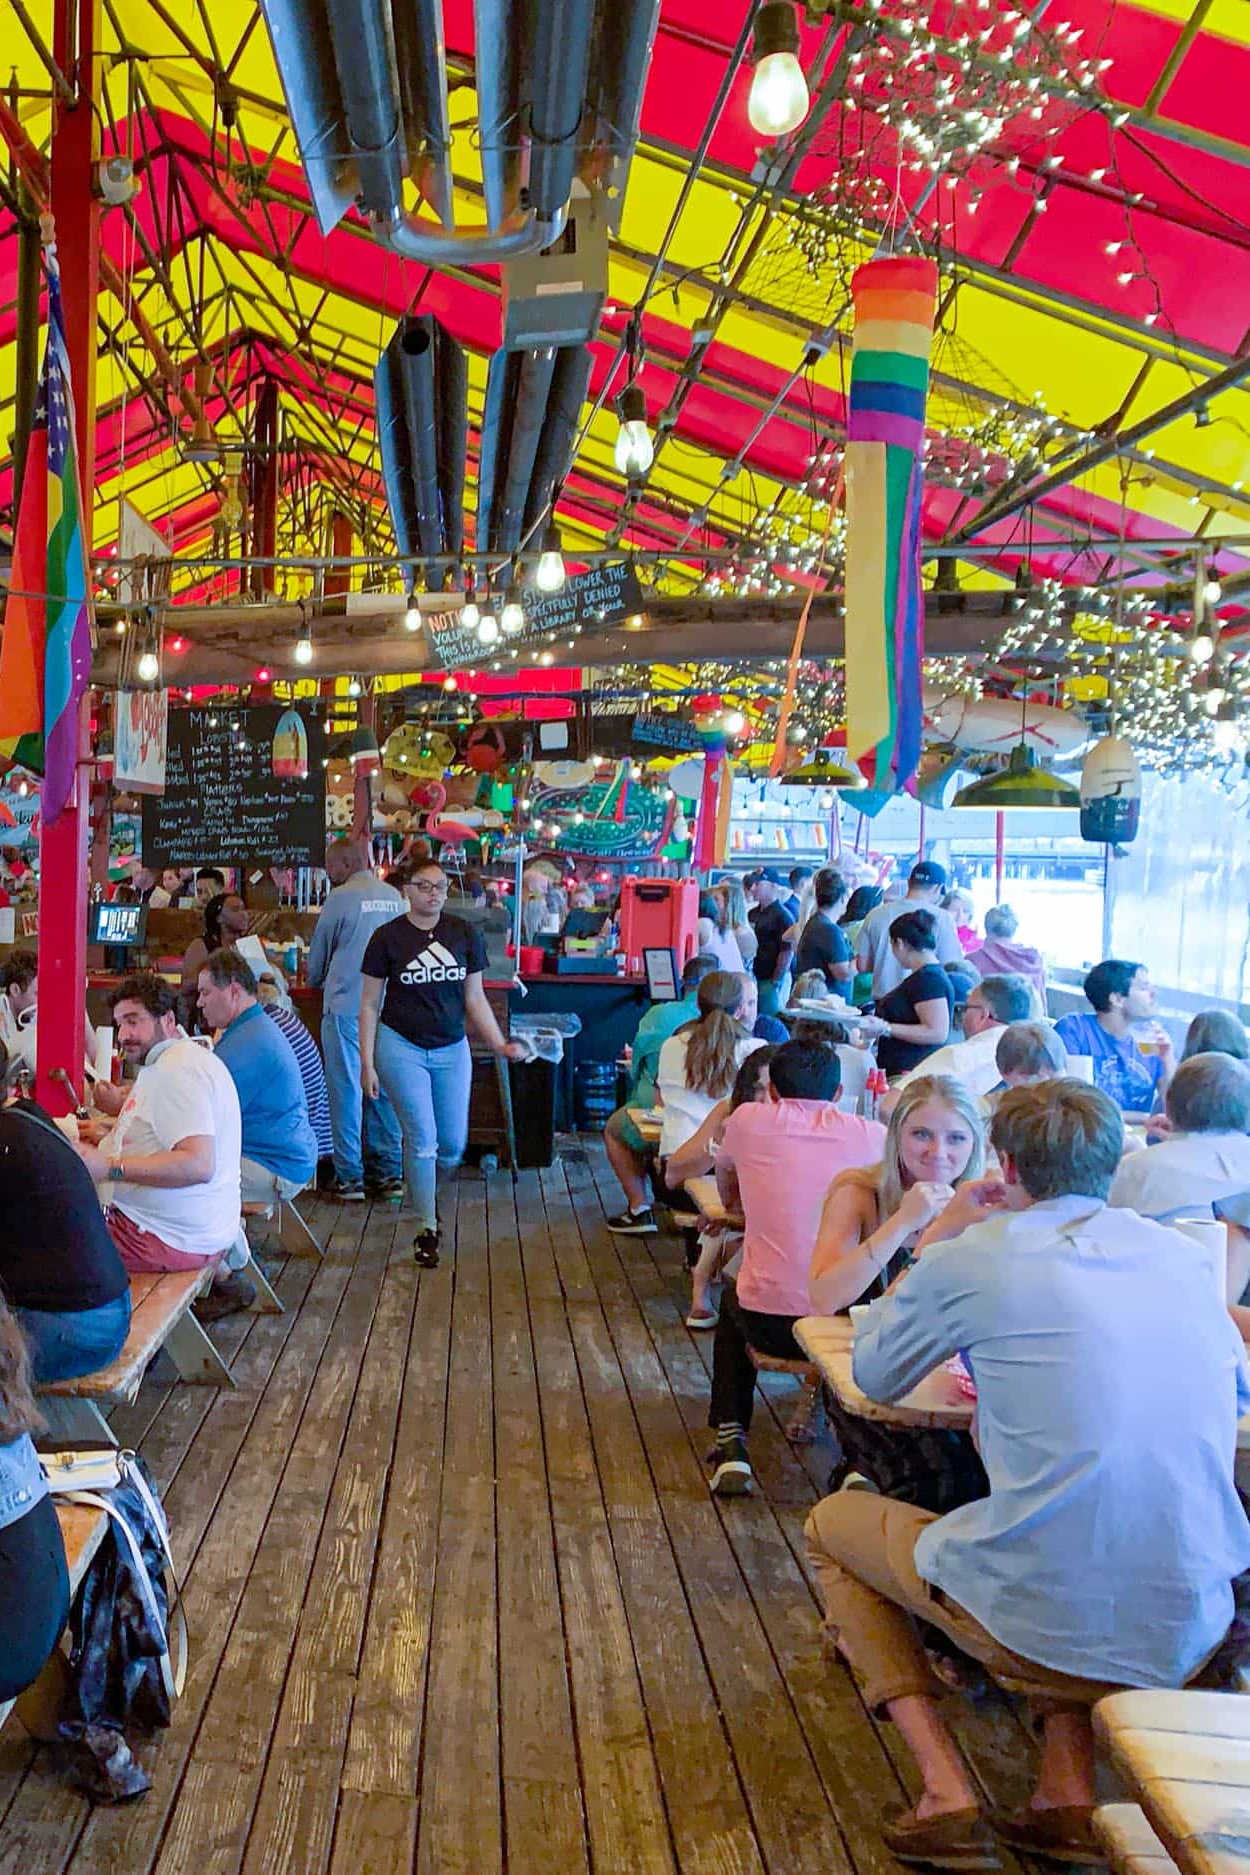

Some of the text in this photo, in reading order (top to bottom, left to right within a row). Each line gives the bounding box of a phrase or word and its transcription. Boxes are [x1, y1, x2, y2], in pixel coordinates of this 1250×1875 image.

[606, 565, 629, 582] THE
[522, 596, 579, 619] ESPECTFULLY
[583, 586, 622, 605] DENIED
[361, 900, 399, 912] SECURITY
[400, 966, 467, 984] adidas
